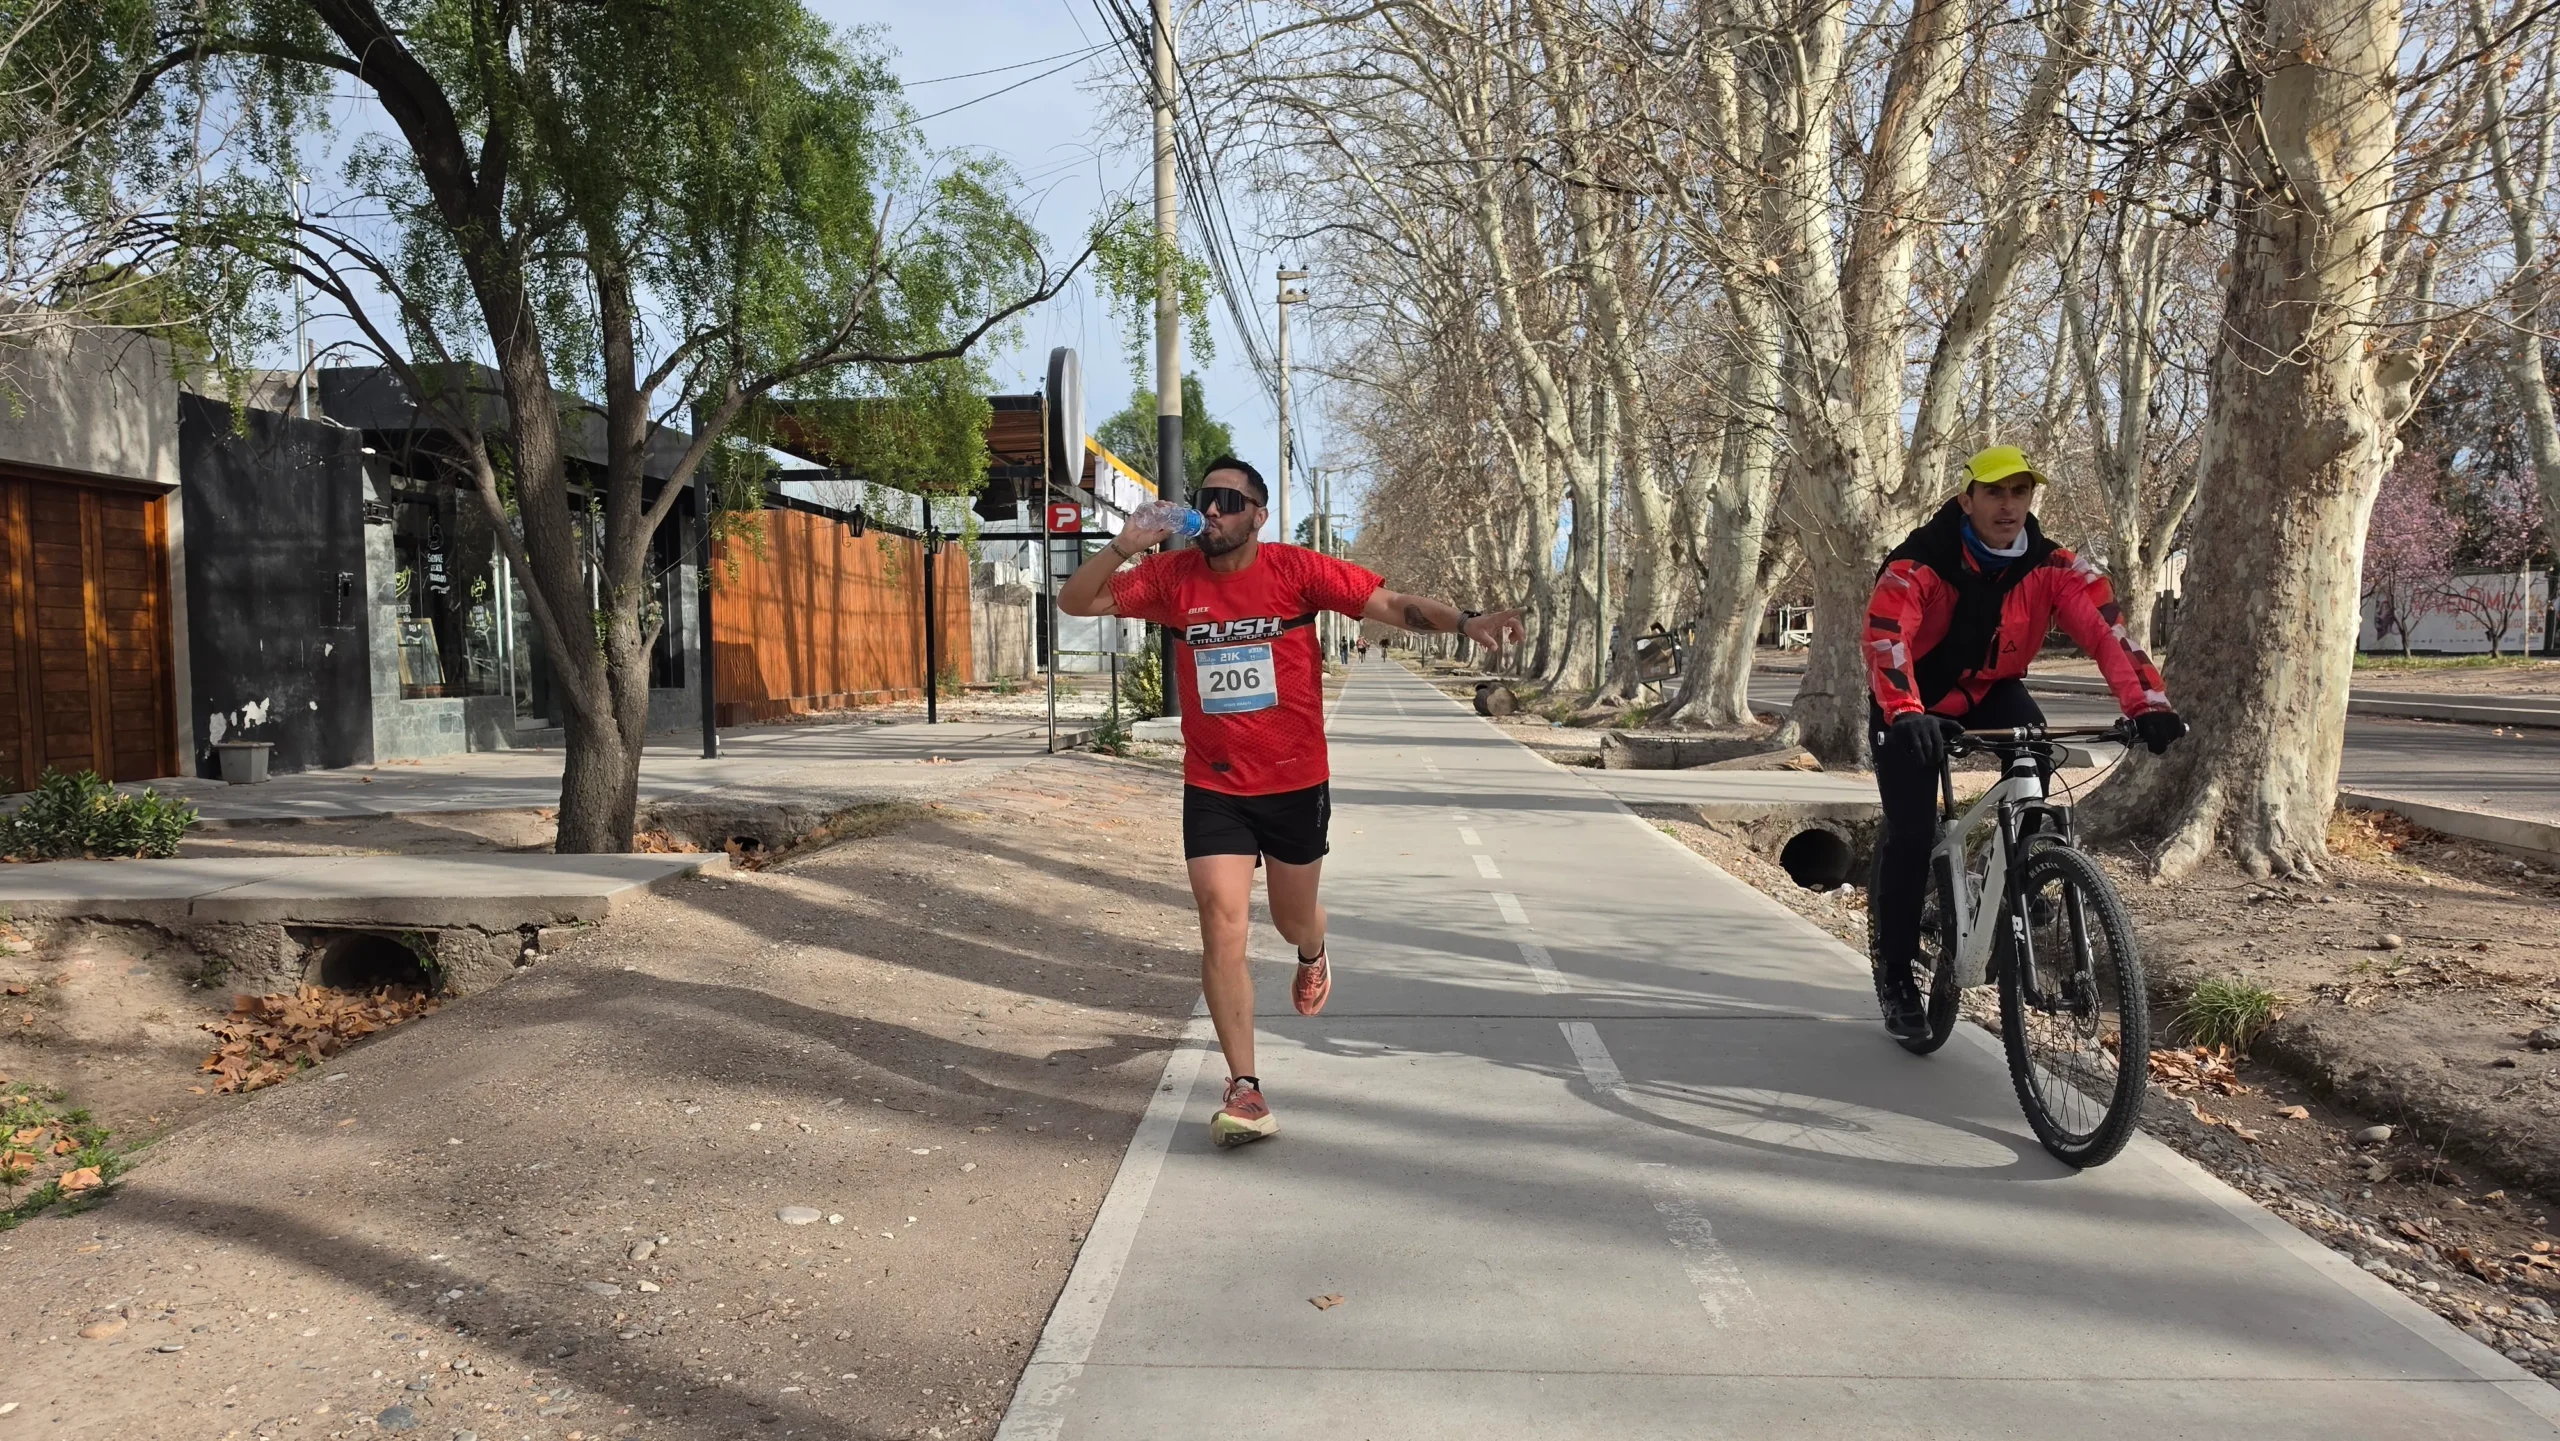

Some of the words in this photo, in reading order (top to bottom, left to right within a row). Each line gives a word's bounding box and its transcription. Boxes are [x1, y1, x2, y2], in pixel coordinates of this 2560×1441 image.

[1055, 507, 1077, 528] P
[1186, 617, 1281, 640] PUSH
[1187, 637, 1225, 645] ACTITUD
[1227, 631, 1283, 641] DEPORTIVA
[1220, 652, 1240, 662] 21K
[1209, 667, 1260, 693] 206
